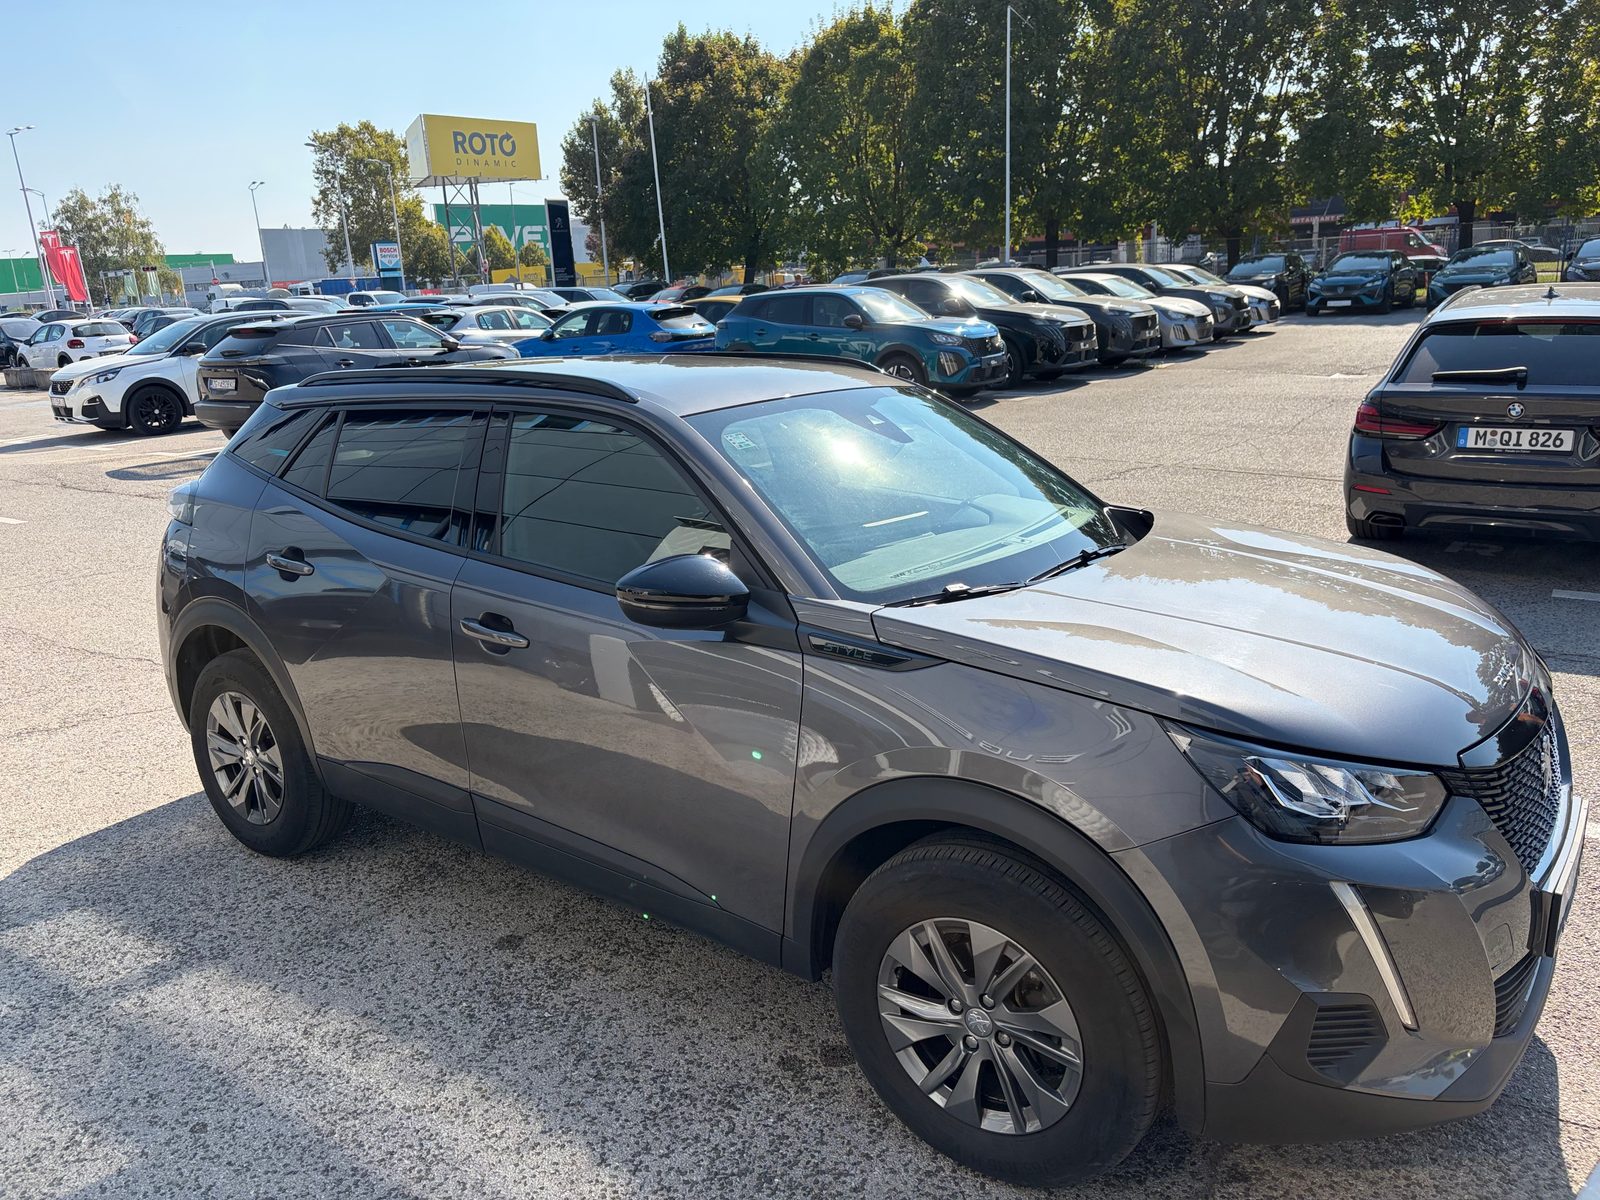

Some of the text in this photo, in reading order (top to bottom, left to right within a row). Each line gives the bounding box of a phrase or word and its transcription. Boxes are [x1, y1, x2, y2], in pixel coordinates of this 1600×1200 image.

[452, 131, 516, 157] ROTO
[456, 158, 517, 168] DINAMIC
[1474, 429, 1564, 448] M QI 826
[823, 642, 872, 660] STYLE
